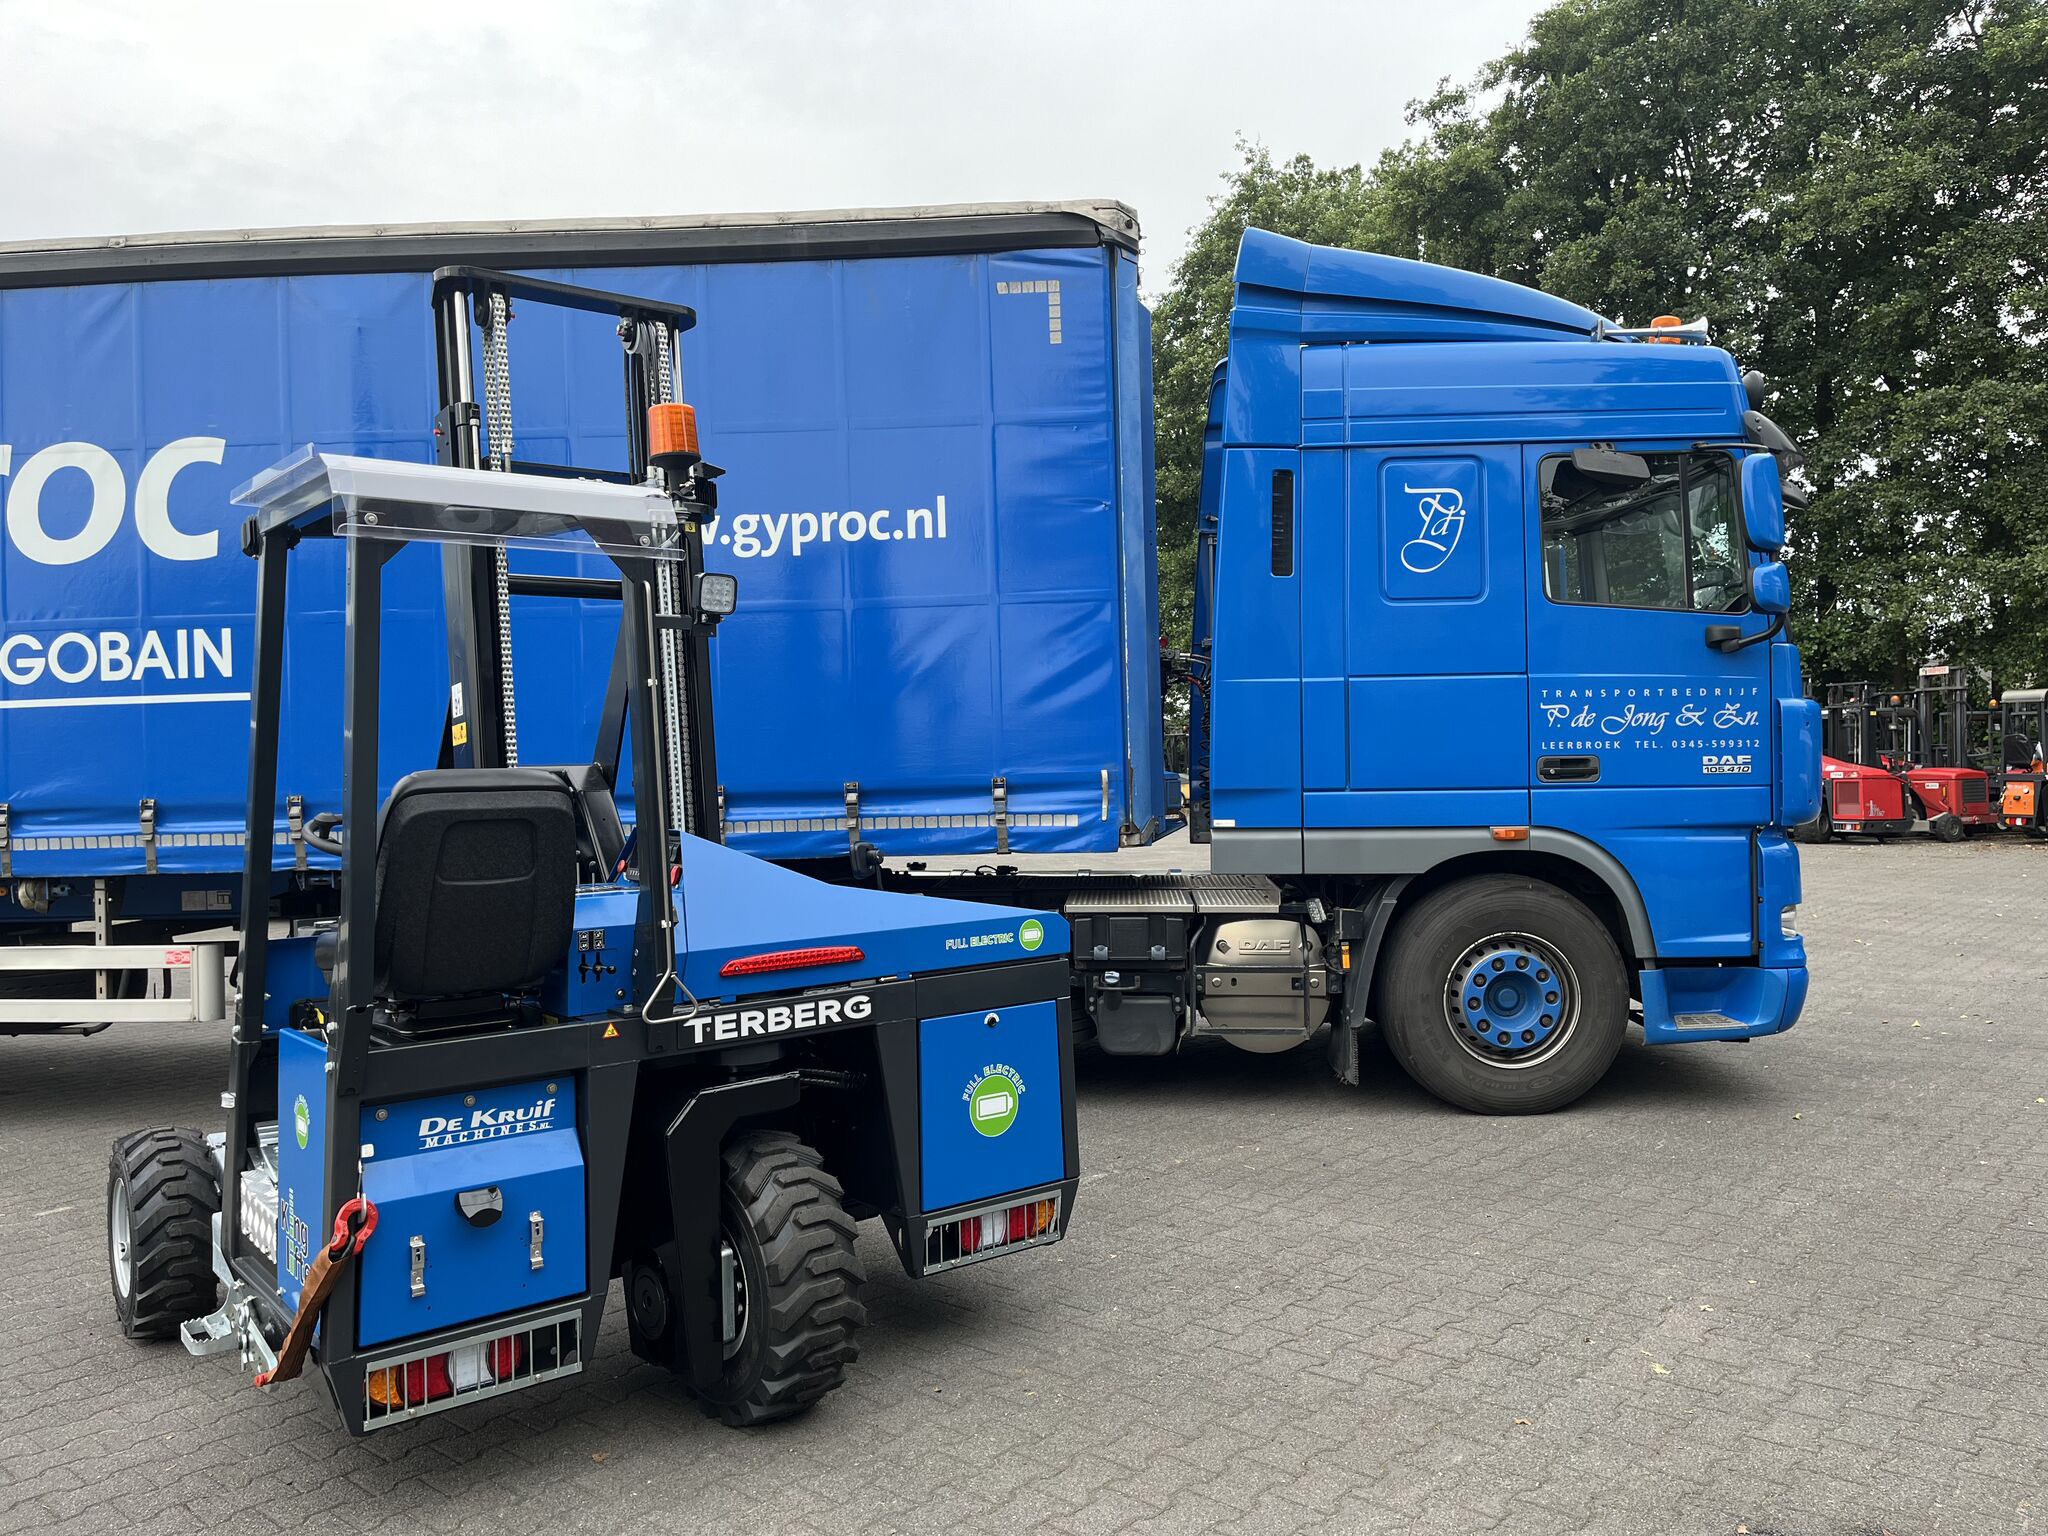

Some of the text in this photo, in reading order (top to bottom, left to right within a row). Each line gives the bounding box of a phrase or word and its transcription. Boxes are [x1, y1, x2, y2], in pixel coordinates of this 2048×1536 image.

[0, 628, 233, 685] GOBAIN
[1541, 688, 1758, 698] TRANSPORTBEDRIJF
[1570, 704, 1597, 728] de
[1601, 704, 1670, 735] Jong
[1541, 739, 1760, 750] LEERBROEK TEL. 0345-599312
[1702, 755, 1751, 765] DAF
[945, 932, 1015, 951] FULL ELECTRIC
[1240, 939, 1290, 950] DAF
[683, 994, 872, 1045] TERBERG
[961, 1063, 1026, 1102] FULL ELECTRIC
